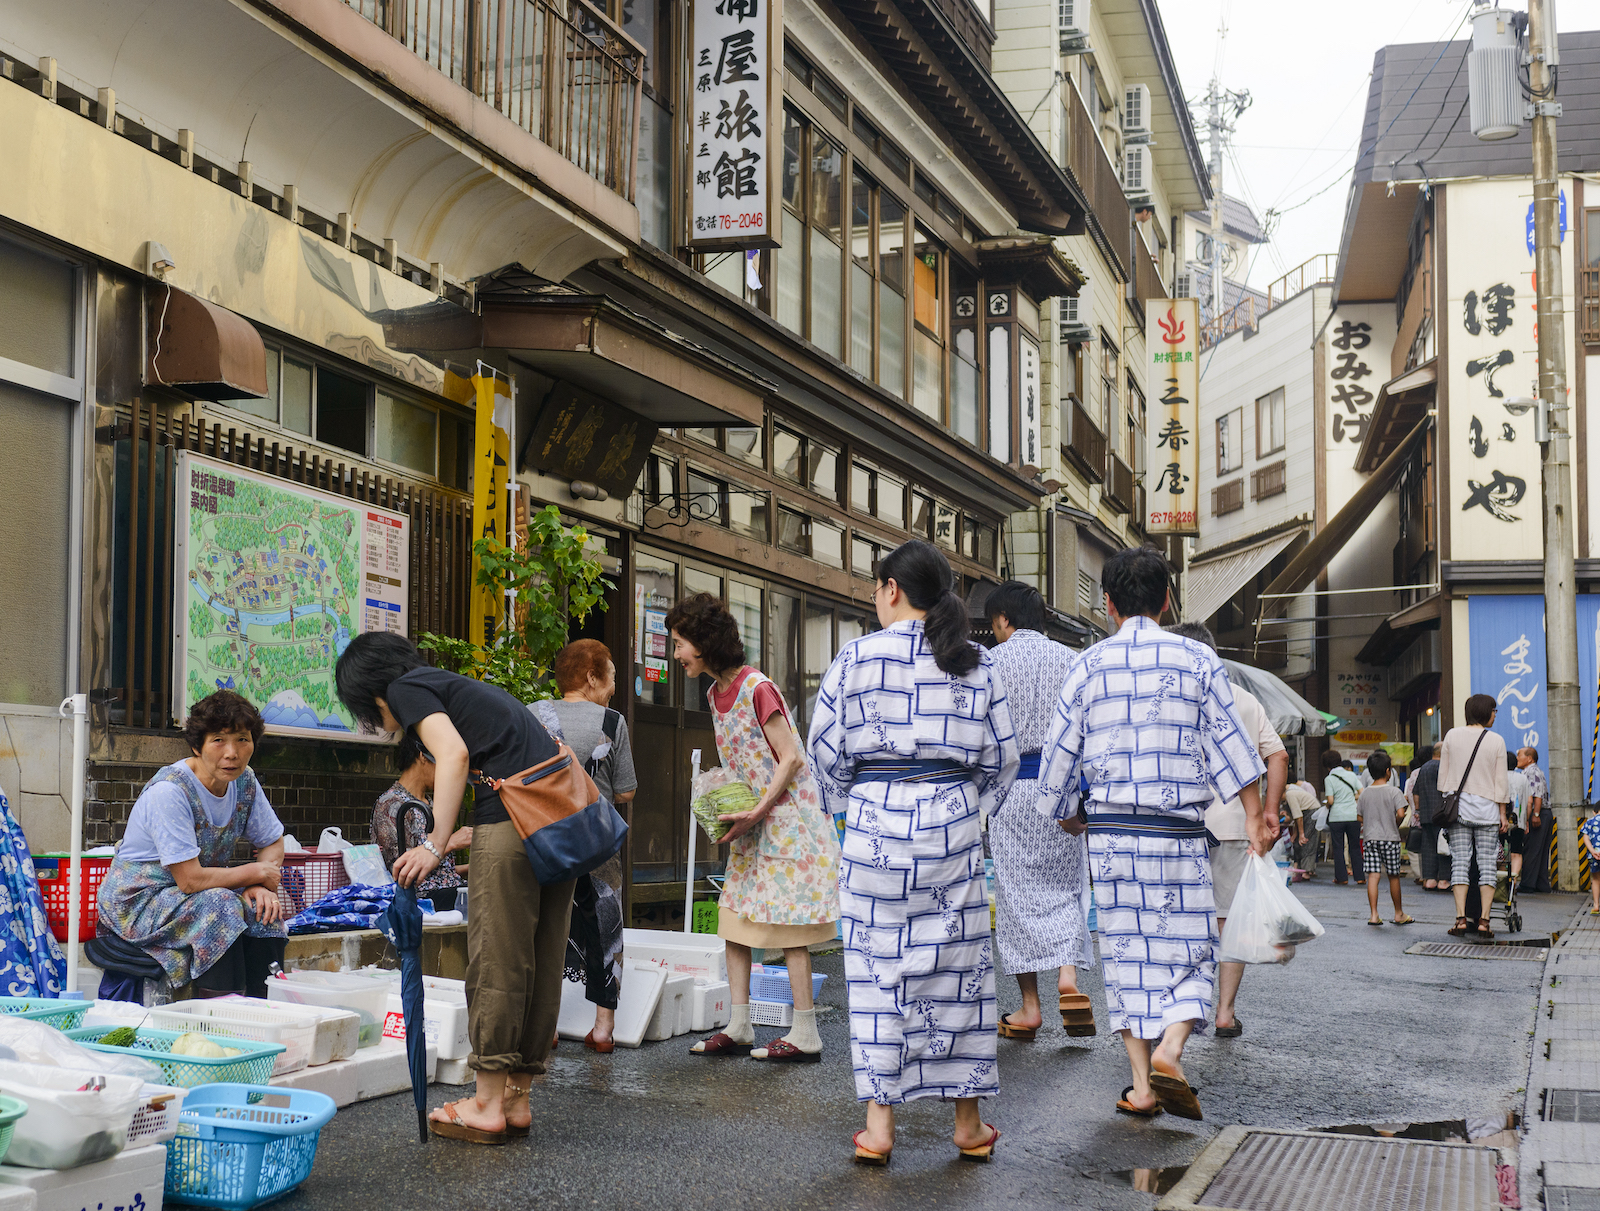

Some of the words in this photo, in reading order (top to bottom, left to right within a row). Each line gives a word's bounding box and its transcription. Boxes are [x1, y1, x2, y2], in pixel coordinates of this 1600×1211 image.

[696, 48, 713, 190] 三原半三郎
[695, 215, 717, 231] 電話
[719, 212, 763, 230] 76-2046
[1331, 321, 1373, 444] おみやげ
[1462, 283, 1526, 522] ほていや
[1154, 378, 1190, 495] 三春屋
[191, 470, 235, 499] 肘折温泉郷
[191, 491, 218, 515] 案内図
[1162, 511, 1196, 523] 76-2261
[1146, 670, 1177, 722] 松屋旅館
[1497, 633, 1540, 754] まんじゅ
[1340, 732, 1382, 742] 宅配便取次
[930, 884, 961, 937] 松屋旅館
[383, 1013, 407, 1038] 鮭
[915, 998, 946, 1055] 松屋旅館
